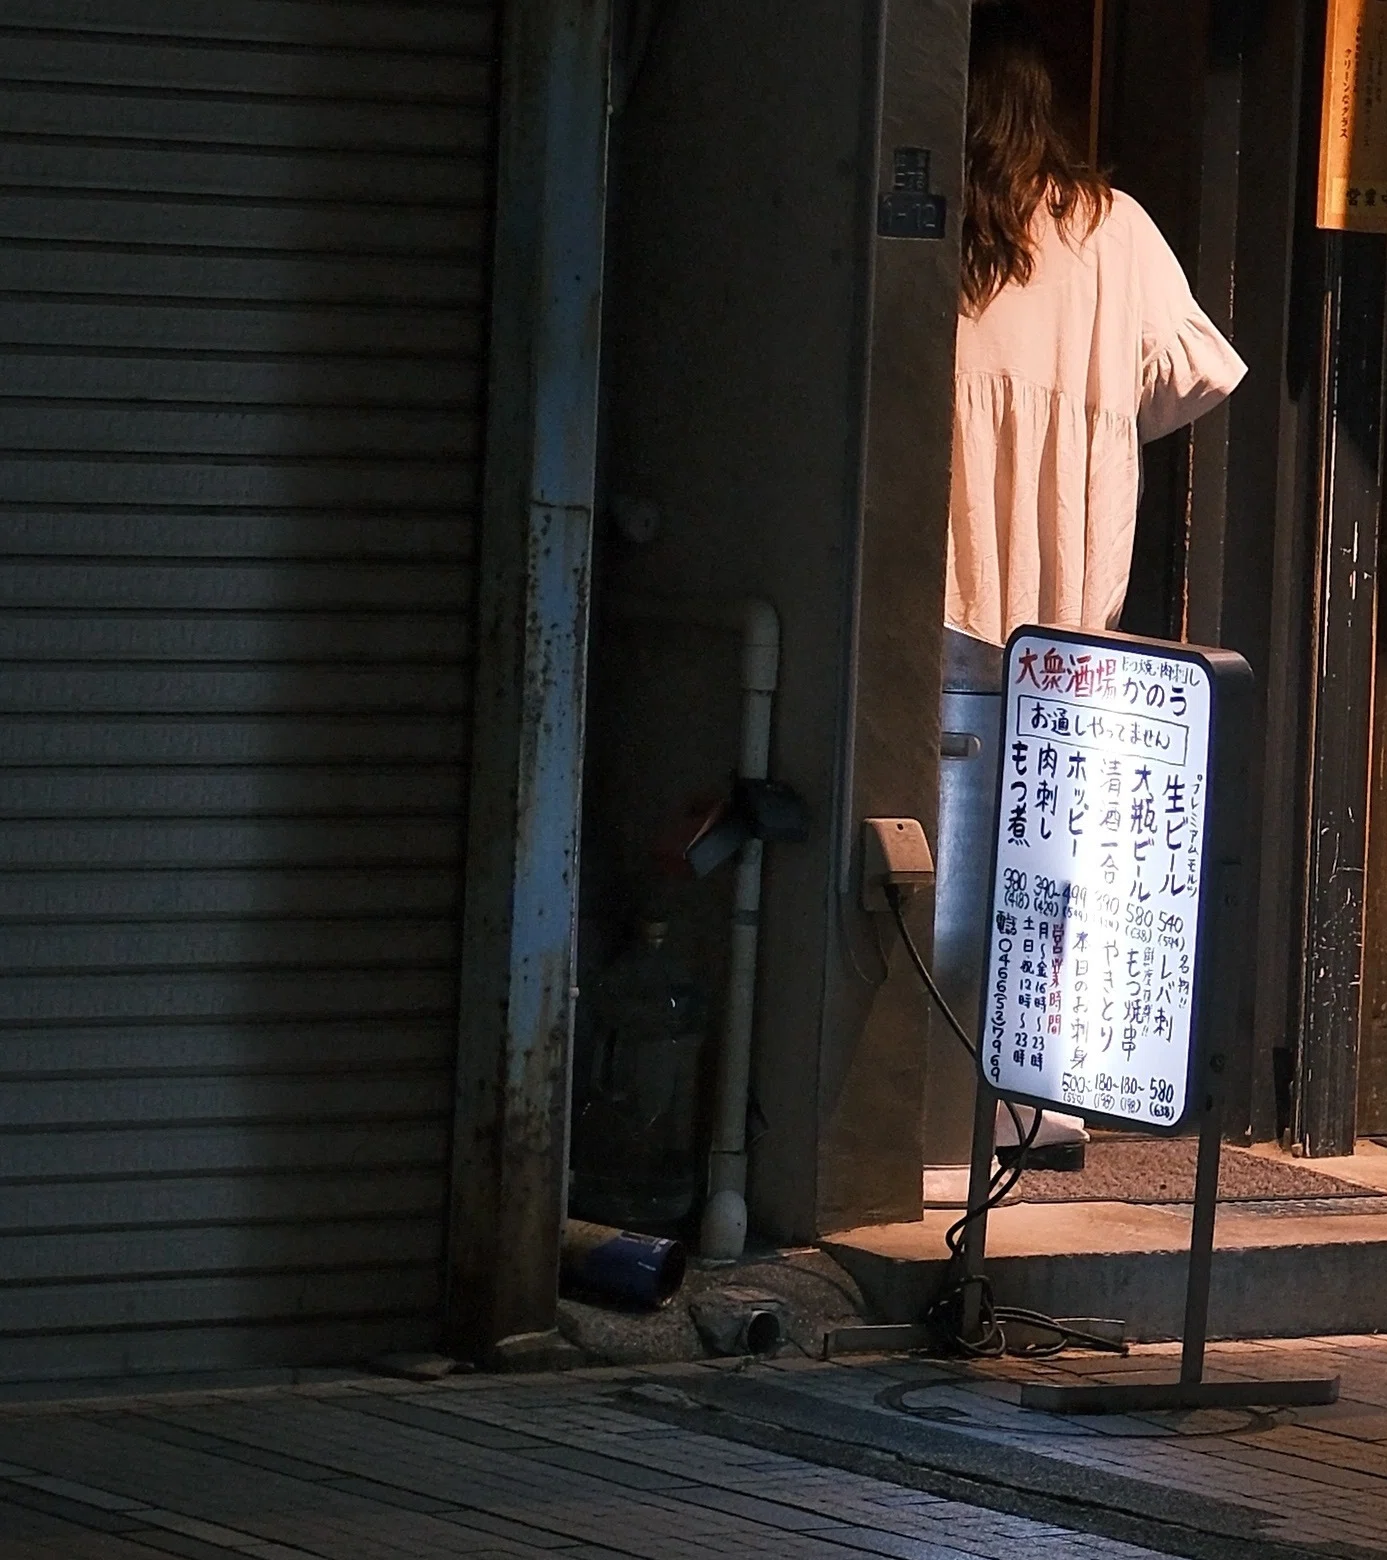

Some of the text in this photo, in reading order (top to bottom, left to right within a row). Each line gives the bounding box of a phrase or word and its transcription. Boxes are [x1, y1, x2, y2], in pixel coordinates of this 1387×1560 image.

[1015, 647, 1117, 700] 大衆酒場
[1122, 677, 1188, 716] かのう
[1031, 702, 1171, 750] お通しやってません
[1007, 741, 1031, 848] もつ煮
[1034, 742, 1059, 840] 肉刺し
[1067, 751, 1091, 858] ホッピー
[1129, 764, 1158, 903] 大瓶ビール
[1159, 774, 1189, 897] 生ビール
[1003, 867, 1028, 892] 380
[1125, 902, 1154, 927] 580
[1157, 910, 1184, 934] 540
[1047, 923, 1065, 1036] 営業時間
[1070, 931, 1090, 1070] 本日のお刺身
[1100, 940, 1120, 1053] やきとり
[1153, 954, 1175, 1043] レバ刺
[1149, 1077, 1175, 1103] 580
[1149, 1102, 1175, 1121] (638)
